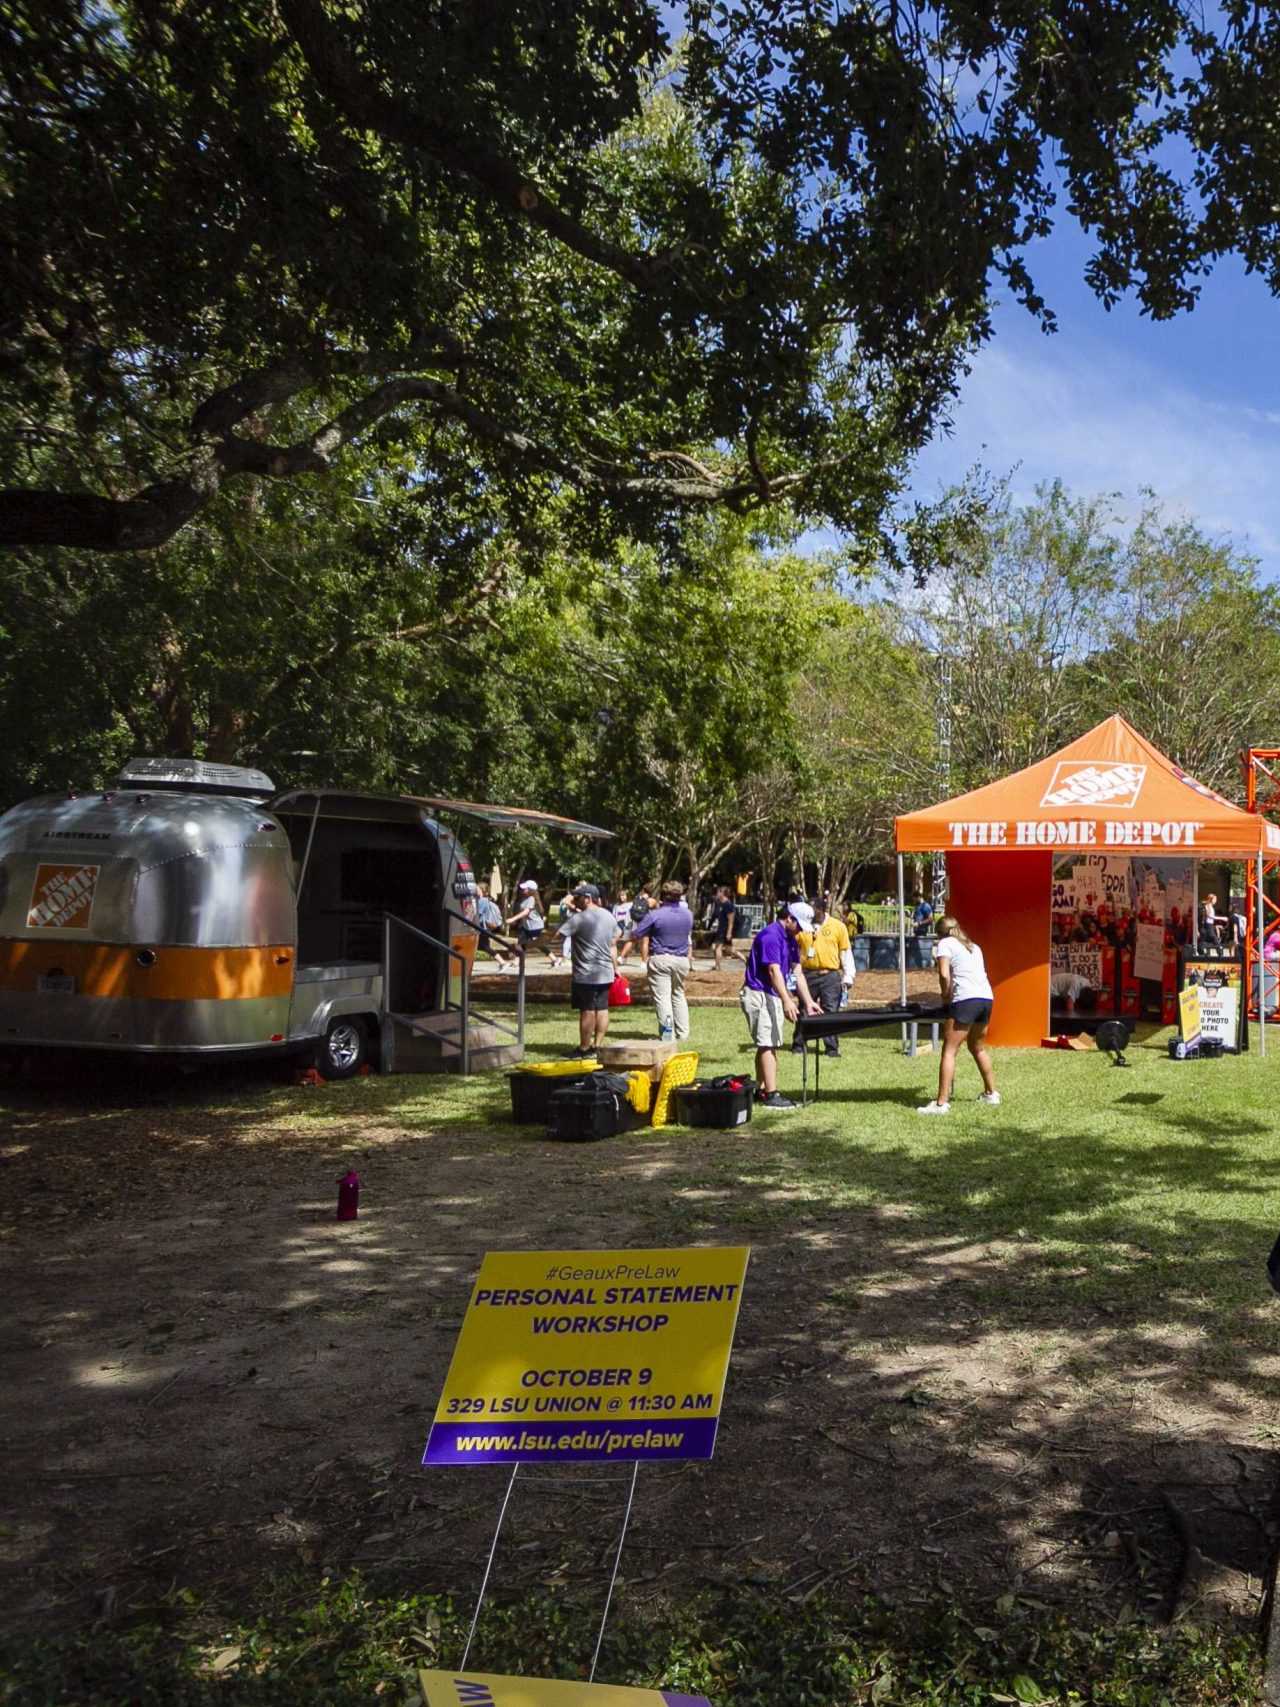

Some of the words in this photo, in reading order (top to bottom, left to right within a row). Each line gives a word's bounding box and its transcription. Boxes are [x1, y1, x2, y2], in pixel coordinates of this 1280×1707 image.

[949, 822, 1007, 846] THE
[1016, 820, 1097, 845] HOME
[1104, 820, 1200, 845] DEPOT
[545, 1264, 680, 1281] #GeauxPreLaw
[475, 1288, 597, 1306] PERSONAL
[604, 1284, 738, 1304] STATEMENT
[532, 1314, 669, 1334] WORKSHOP
[521, 1369, 628, 1387] OCTOBER
[638, 1368, 653, 1386] 9
[446, 1398, 484, 1414] 329
[489, 1397, 530, 1413] LSU
[535, 1396, 602, 1412] UNION
[606, 1398, 624, 1413] @
[628, 1394, 676, 1411] 11:30
[680, 1393, 713, 1409] AM
[456, 1430, 684, 1452] www.lsu.edu/prelaw
